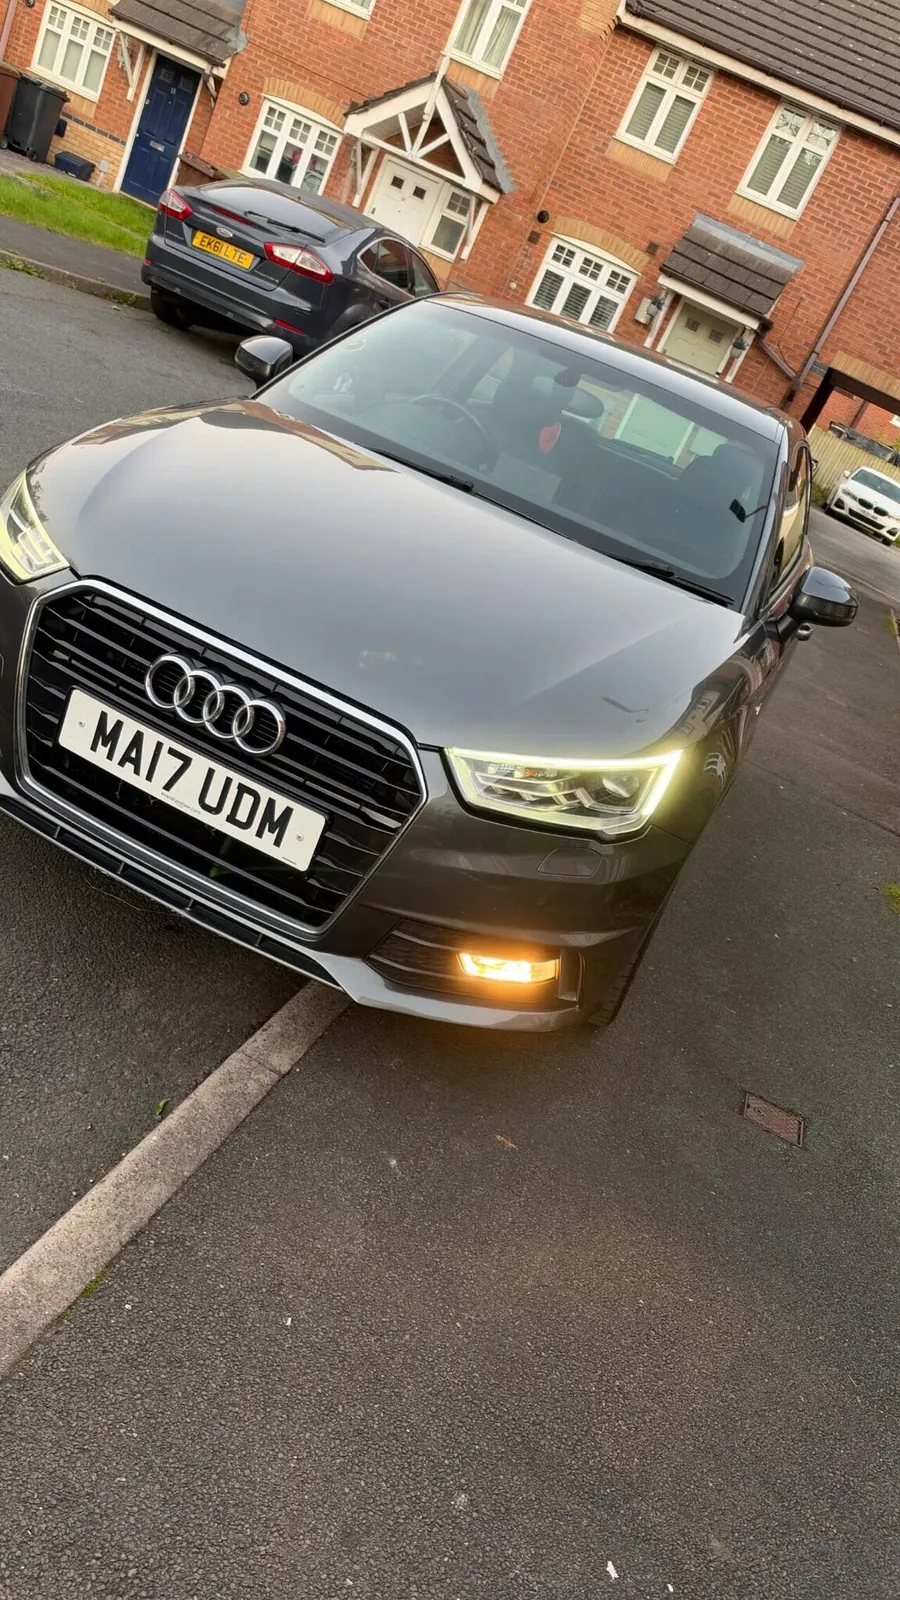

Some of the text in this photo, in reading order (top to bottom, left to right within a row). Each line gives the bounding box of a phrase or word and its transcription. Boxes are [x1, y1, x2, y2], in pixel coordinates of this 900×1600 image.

[200, 236, 247, 263] EK61 LTE
[90, 711, 294, 848] MA17 UDM
